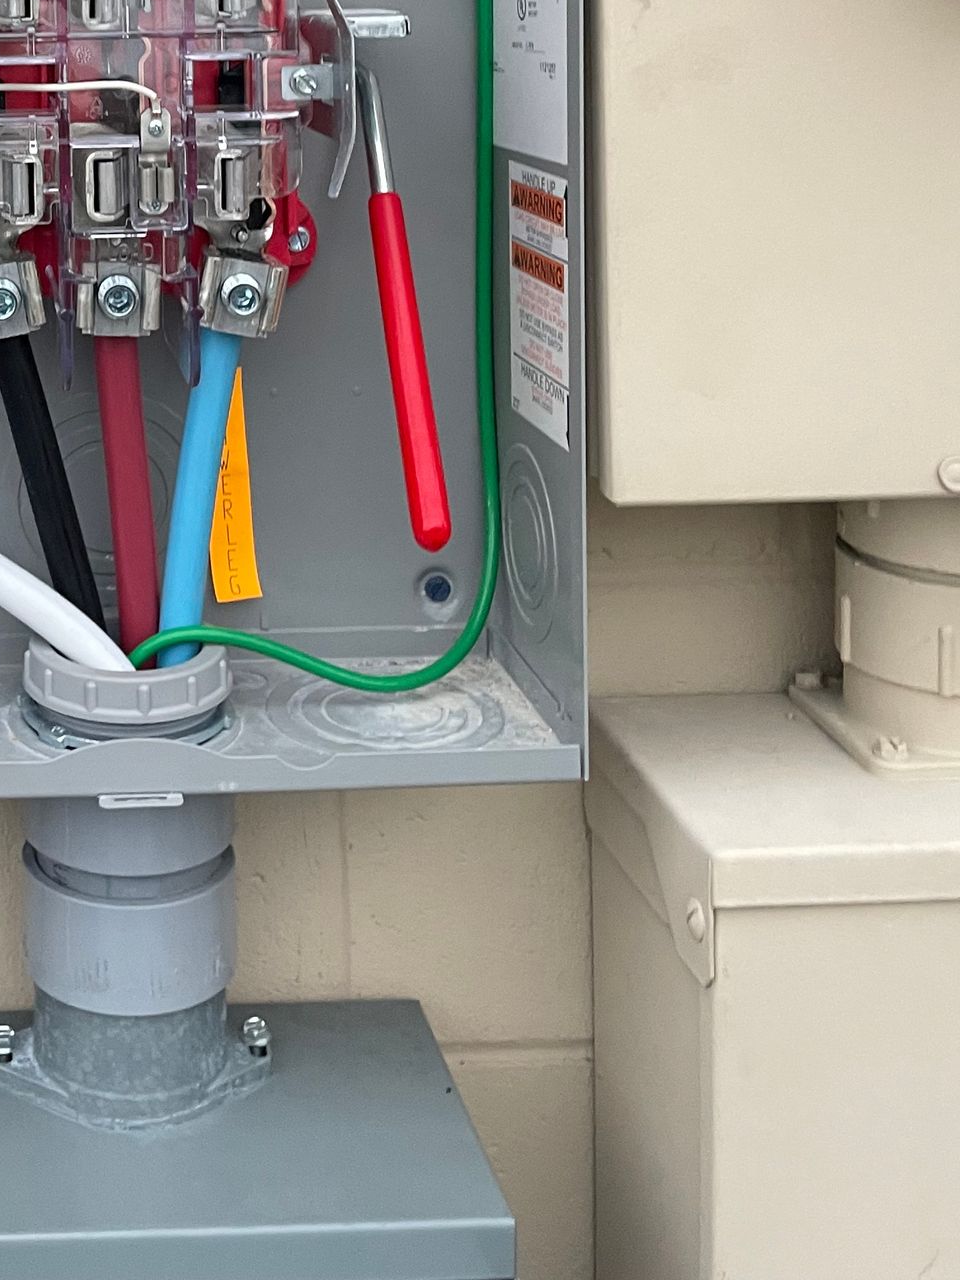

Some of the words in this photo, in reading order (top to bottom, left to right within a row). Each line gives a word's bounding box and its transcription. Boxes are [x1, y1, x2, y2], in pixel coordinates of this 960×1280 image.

[520, 186, 563, 224] WARNING
[520, 244, 563, 285] WARNING
[521, 361, 544, 390] HANDLE
[544, 377, 565, 405] DOWN
[226, 528, 242, 596] LEG
